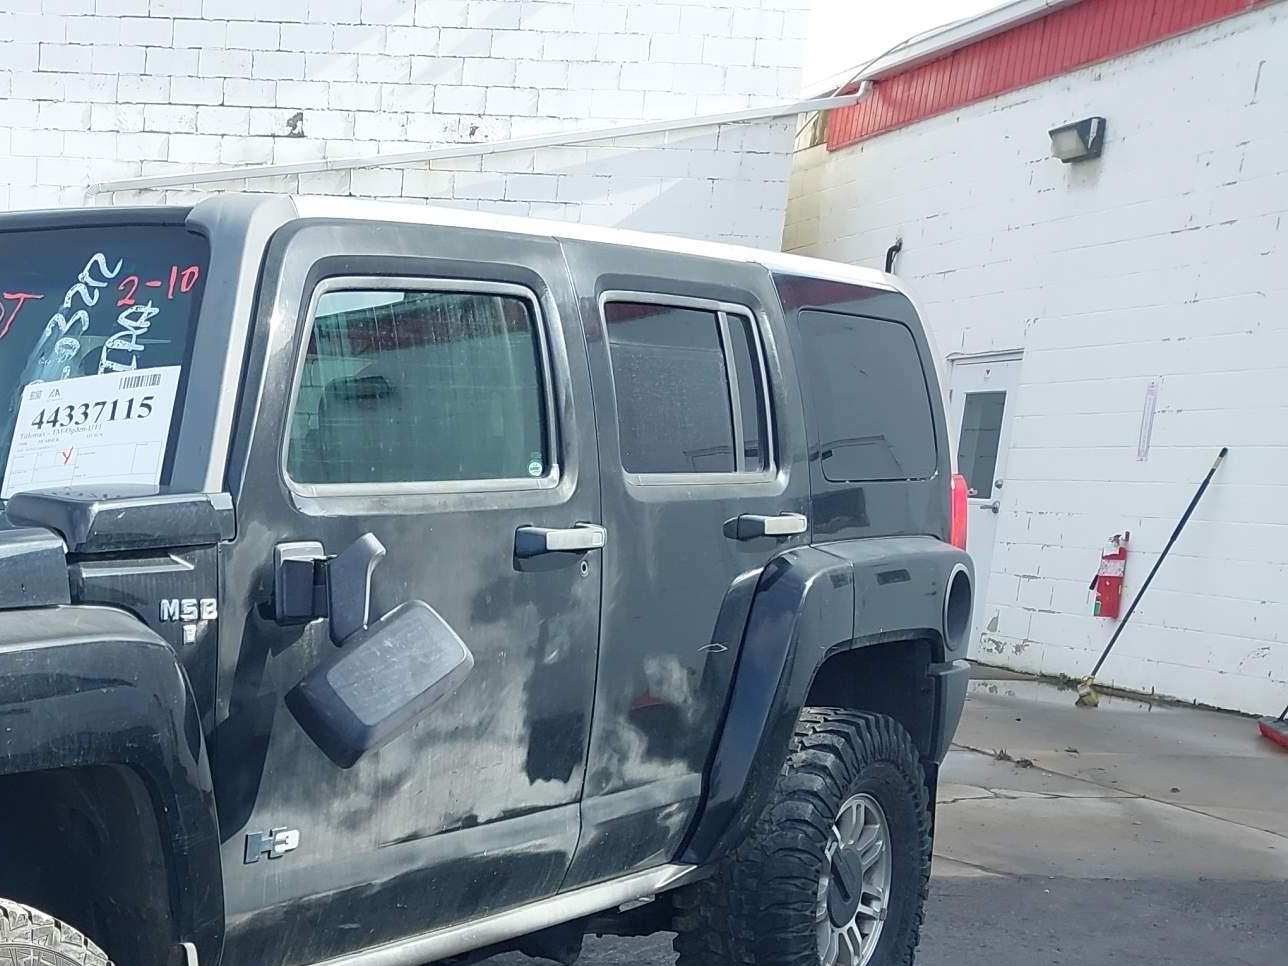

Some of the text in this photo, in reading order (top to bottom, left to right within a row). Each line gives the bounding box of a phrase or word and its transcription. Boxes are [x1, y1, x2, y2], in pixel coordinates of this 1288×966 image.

[117, 265, 200, 306] 2-10
[31, 395, 155, 430] 44337115
[159, 598, 218, 621] MSB
[243, 826, 300, 865] H3
